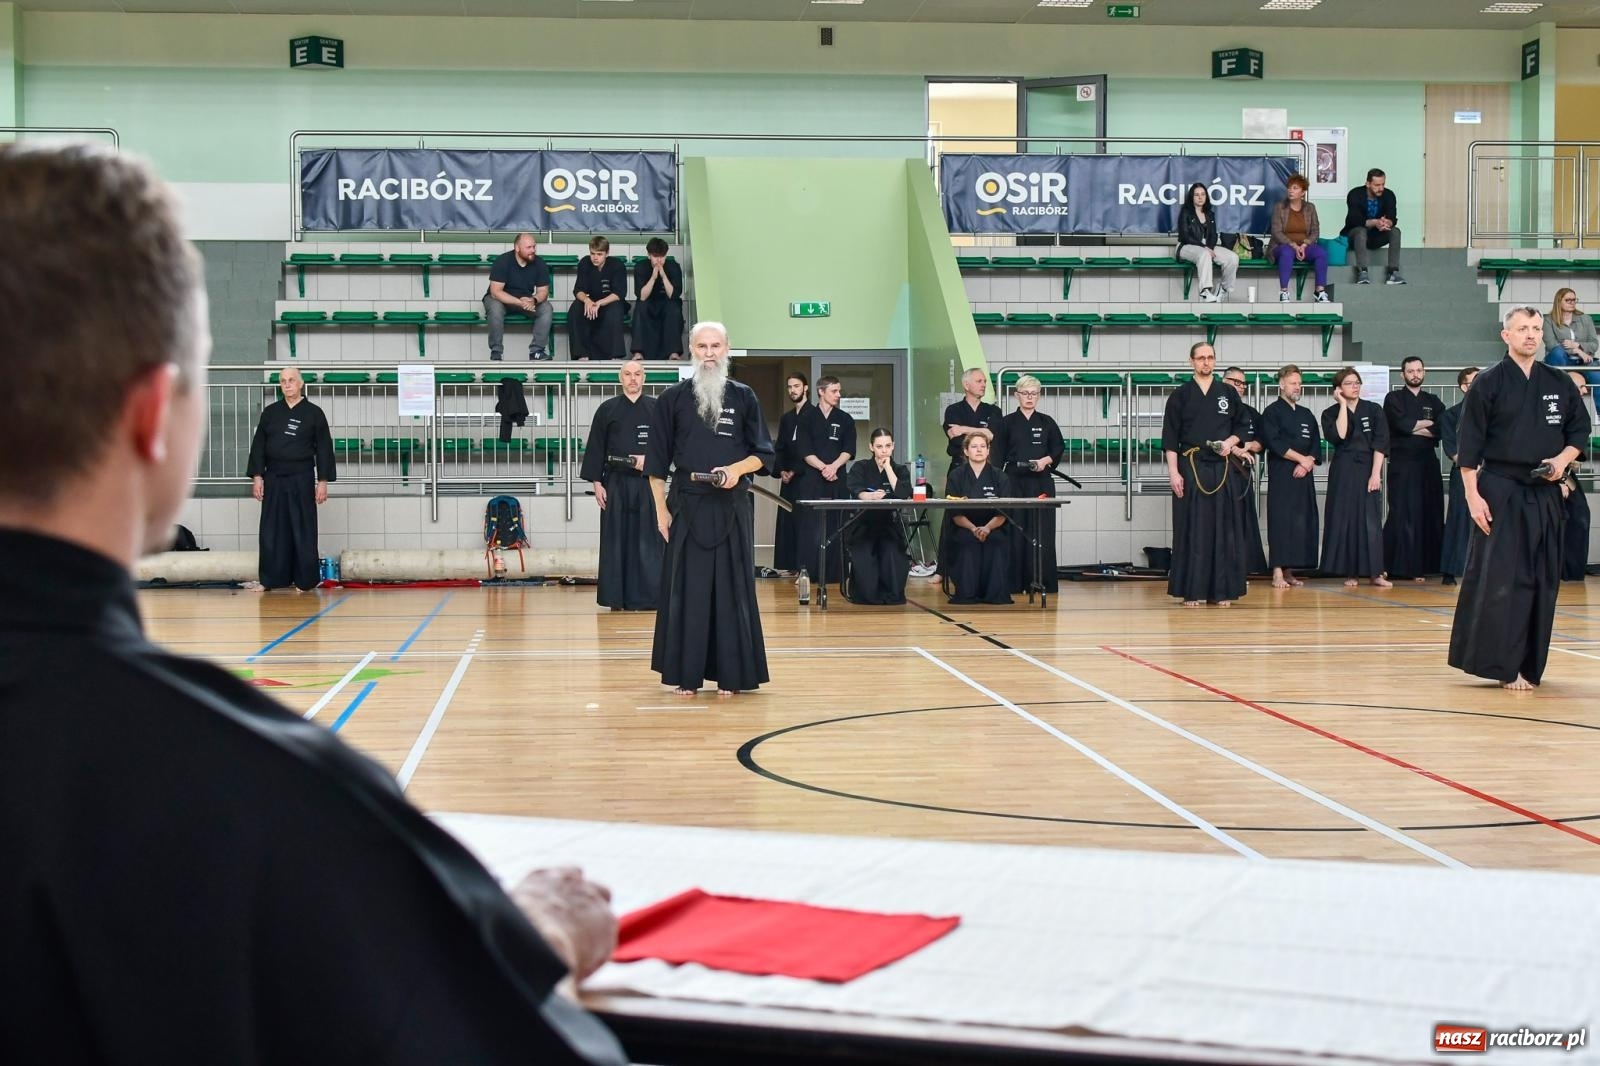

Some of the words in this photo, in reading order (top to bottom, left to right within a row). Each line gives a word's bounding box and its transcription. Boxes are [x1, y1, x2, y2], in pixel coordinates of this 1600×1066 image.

[296, 46, 308, 64] E
[322, 46, 337, 64] E
[1526, 52, 1536, 75] F
[1221, 58, 1237, 75] F
[1250, 58, 1259, 74] F
[338, 171, 493, 201] RACIBÓRZ
[1118, 177, 1266, 206] RACIÓRZ
[581, 202, 639, 214] RACIBÓRZ
[1012, 204, 1068, 216] RACIBÓRZ
